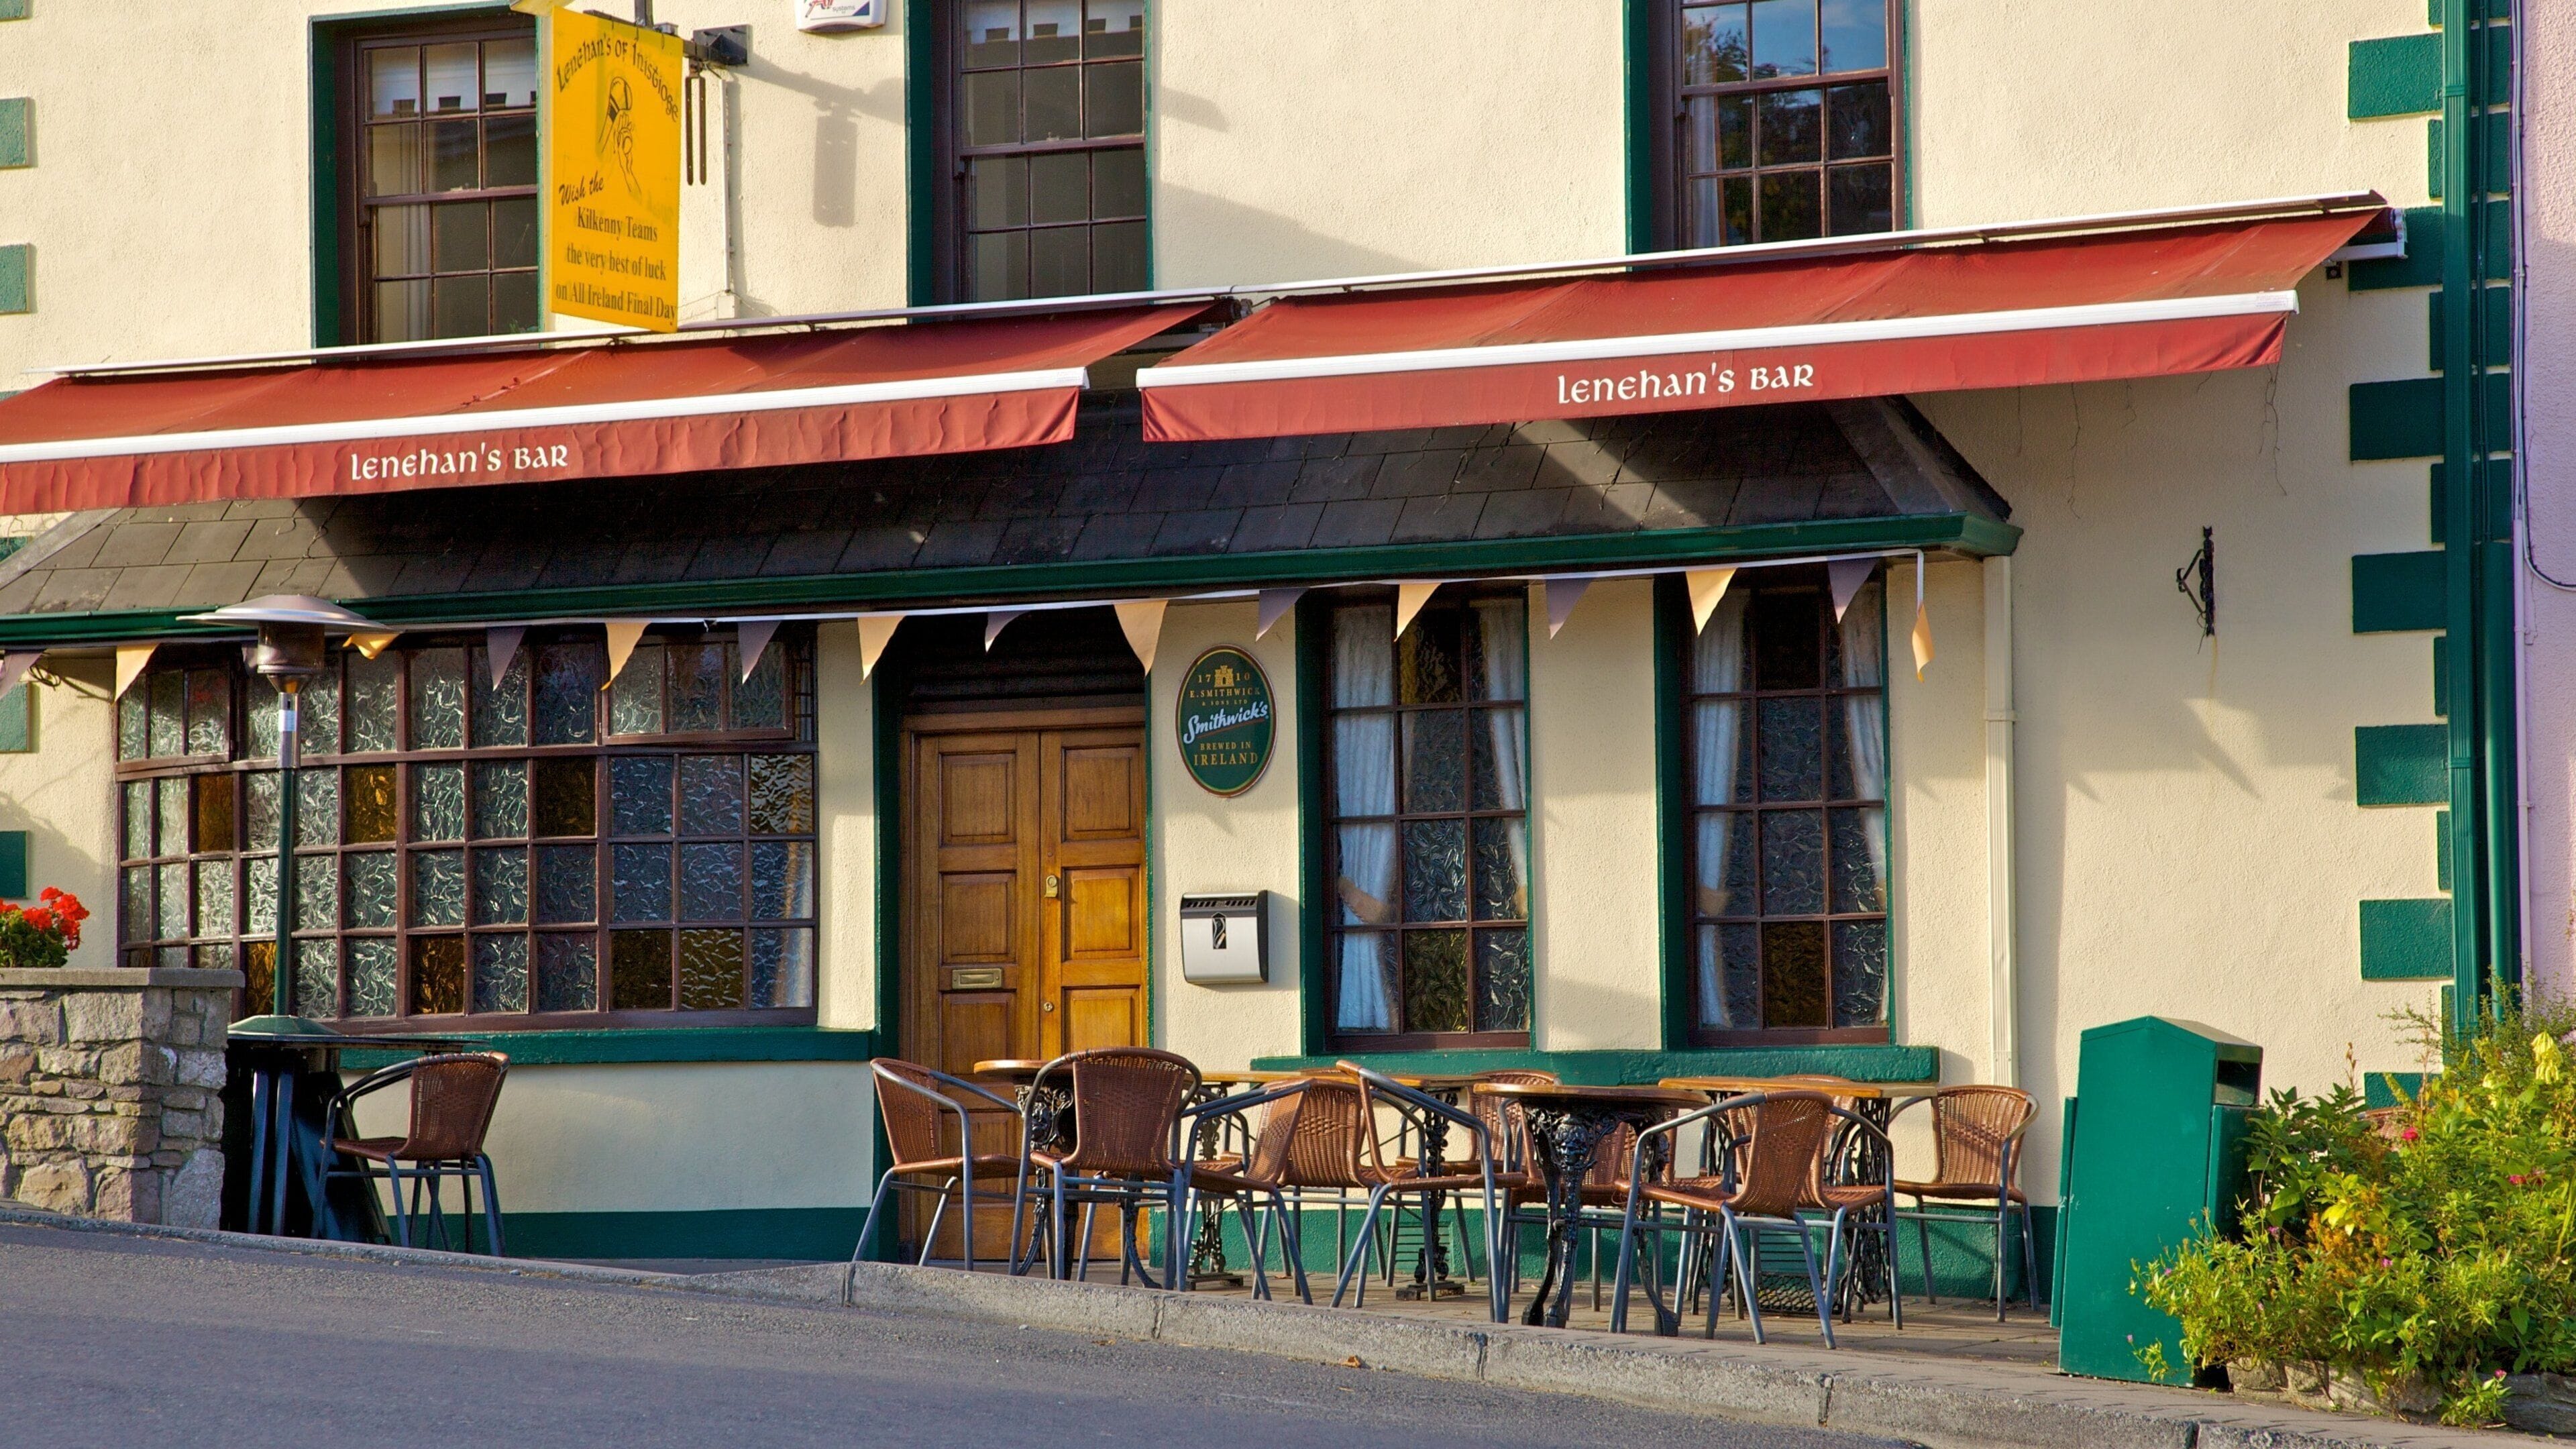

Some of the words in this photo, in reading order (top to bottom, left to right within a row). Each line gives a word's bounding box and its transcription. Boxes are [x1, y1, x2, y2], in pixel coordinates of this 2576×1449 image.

[556, 33, 612, 93] Lenehan's
[633, 38, 679, 122] Inistioge
[559, 176, 586, 206] Wish
[590, 170, 604, 195] the
[578, 206, 623, 241] Kilkenny
[626, 215, 658, 242] Teams
[567, 242, 582, 265] the
[585, 250, 606, 275] very
[609, 250, 630, 274] best
[632, 255, 643, 277] of
[645, 256, 666, 280] luck
[556, 283, 568, 301] on
[570, 281, 585, 303] All
[588, 284, 623, 311] Ireland
[627, 291, 653, 317] Final
[656, 297, 676, 326] Day
[1750, 364, 1814, 391] BAR
[514, 444, 569, 470] BAR
[1183, 701, 1269, 744] Smithwick's
[1194, 752, 1258, 766] IRELAND
[1200, 742, 1237, 751] BREWED
[1241, 741, 1252, 749] IN
